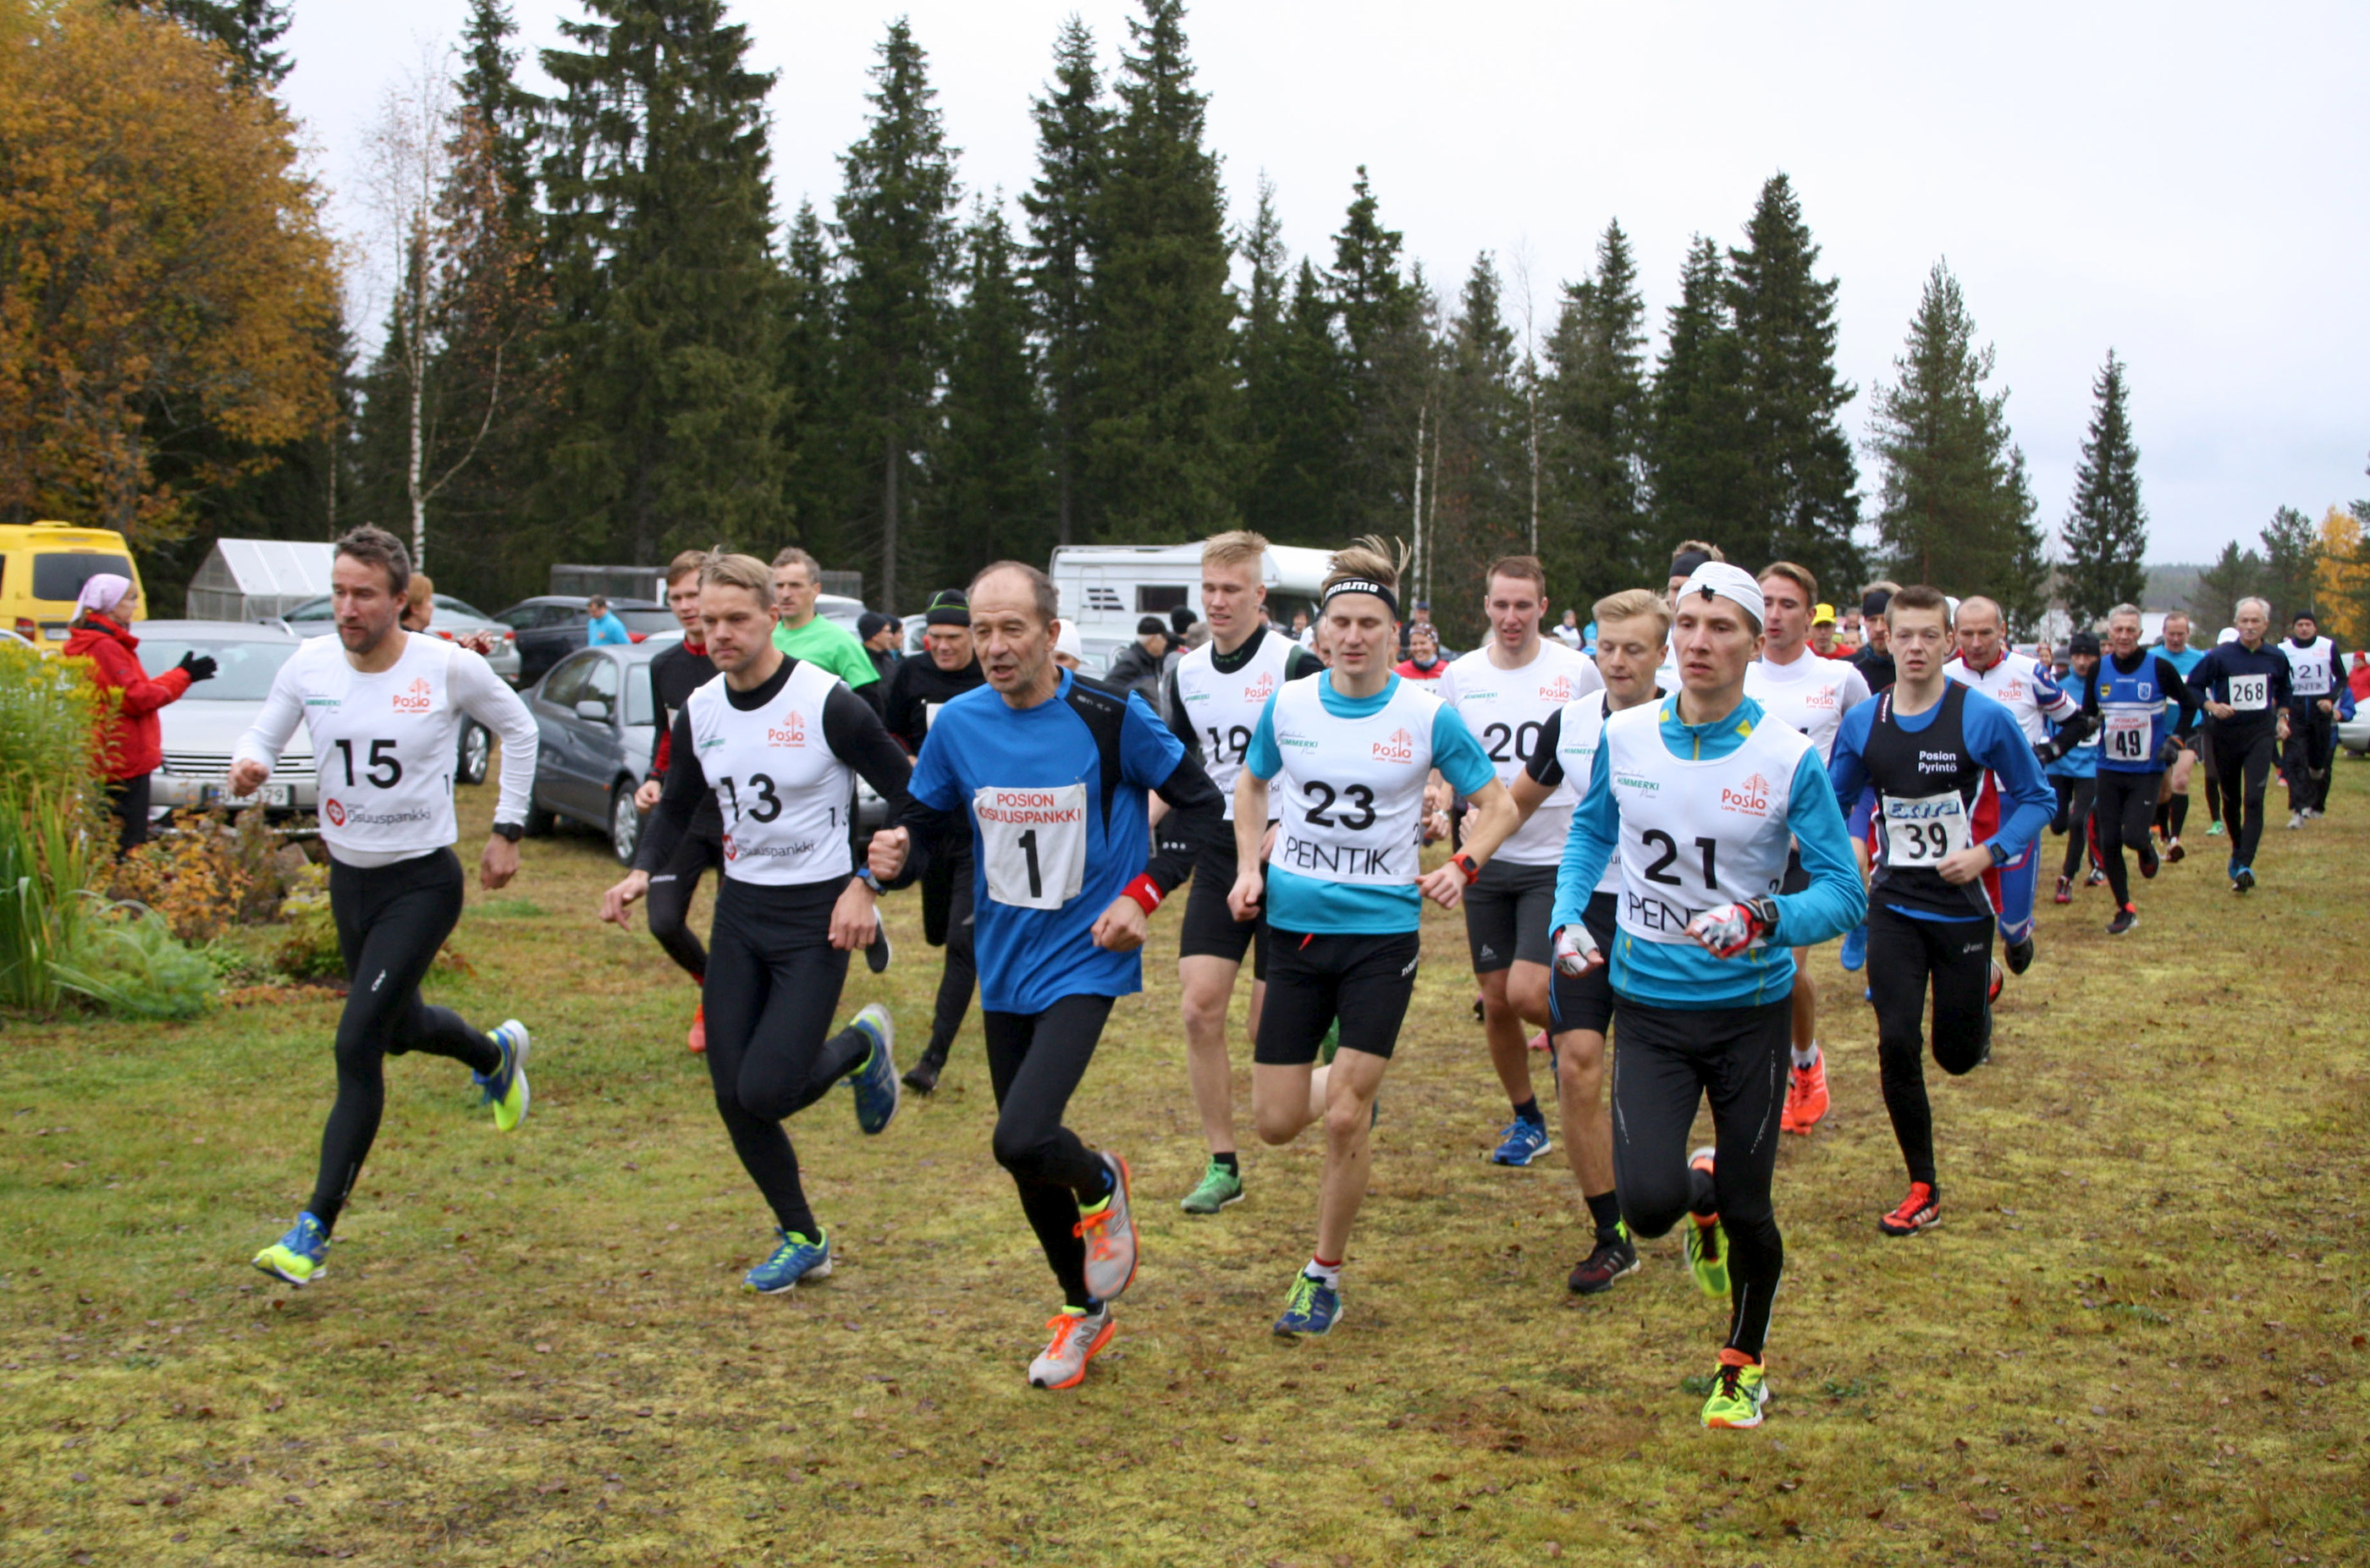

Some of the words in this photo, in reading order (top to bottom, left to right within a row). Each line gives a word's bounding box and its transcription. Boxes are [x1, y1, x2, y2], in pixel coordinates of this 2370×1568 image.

[393, 695, 431, 708] Posio
[1539, 687, 1570, 699] Posio
[1805, 696, 1834, 706] Posio
[2233, 682, 2264, 702] 268
[769, 728, 805, 741] Posio
[1207, 725, 1253, 765] 19
[1483, 720, 1543, 762] 20
[2116, 730, 2141, 756] 49
[1372, 742, 1412, 759] Posio
[1919, 751, 1956, 761] Posion
[334, 739, 403, 790] 15
[1918, 762, 1957, 773] Pyrintö
[720, 773, 782, 823] 13
[996, 793, 1055, 807] POSION
[1304, 780, 1376, 830] 23
[1721, 789, 1767, 810] Posio
[978, 806, 1082, 824] OSUUSPANKKI
[1905, 822, 1948, 859] 39
[1017, 829, 1042, 899] 1
[1284, 835, 1392, 876] PENTIK
[1642, 828, 1718, 890] 21
